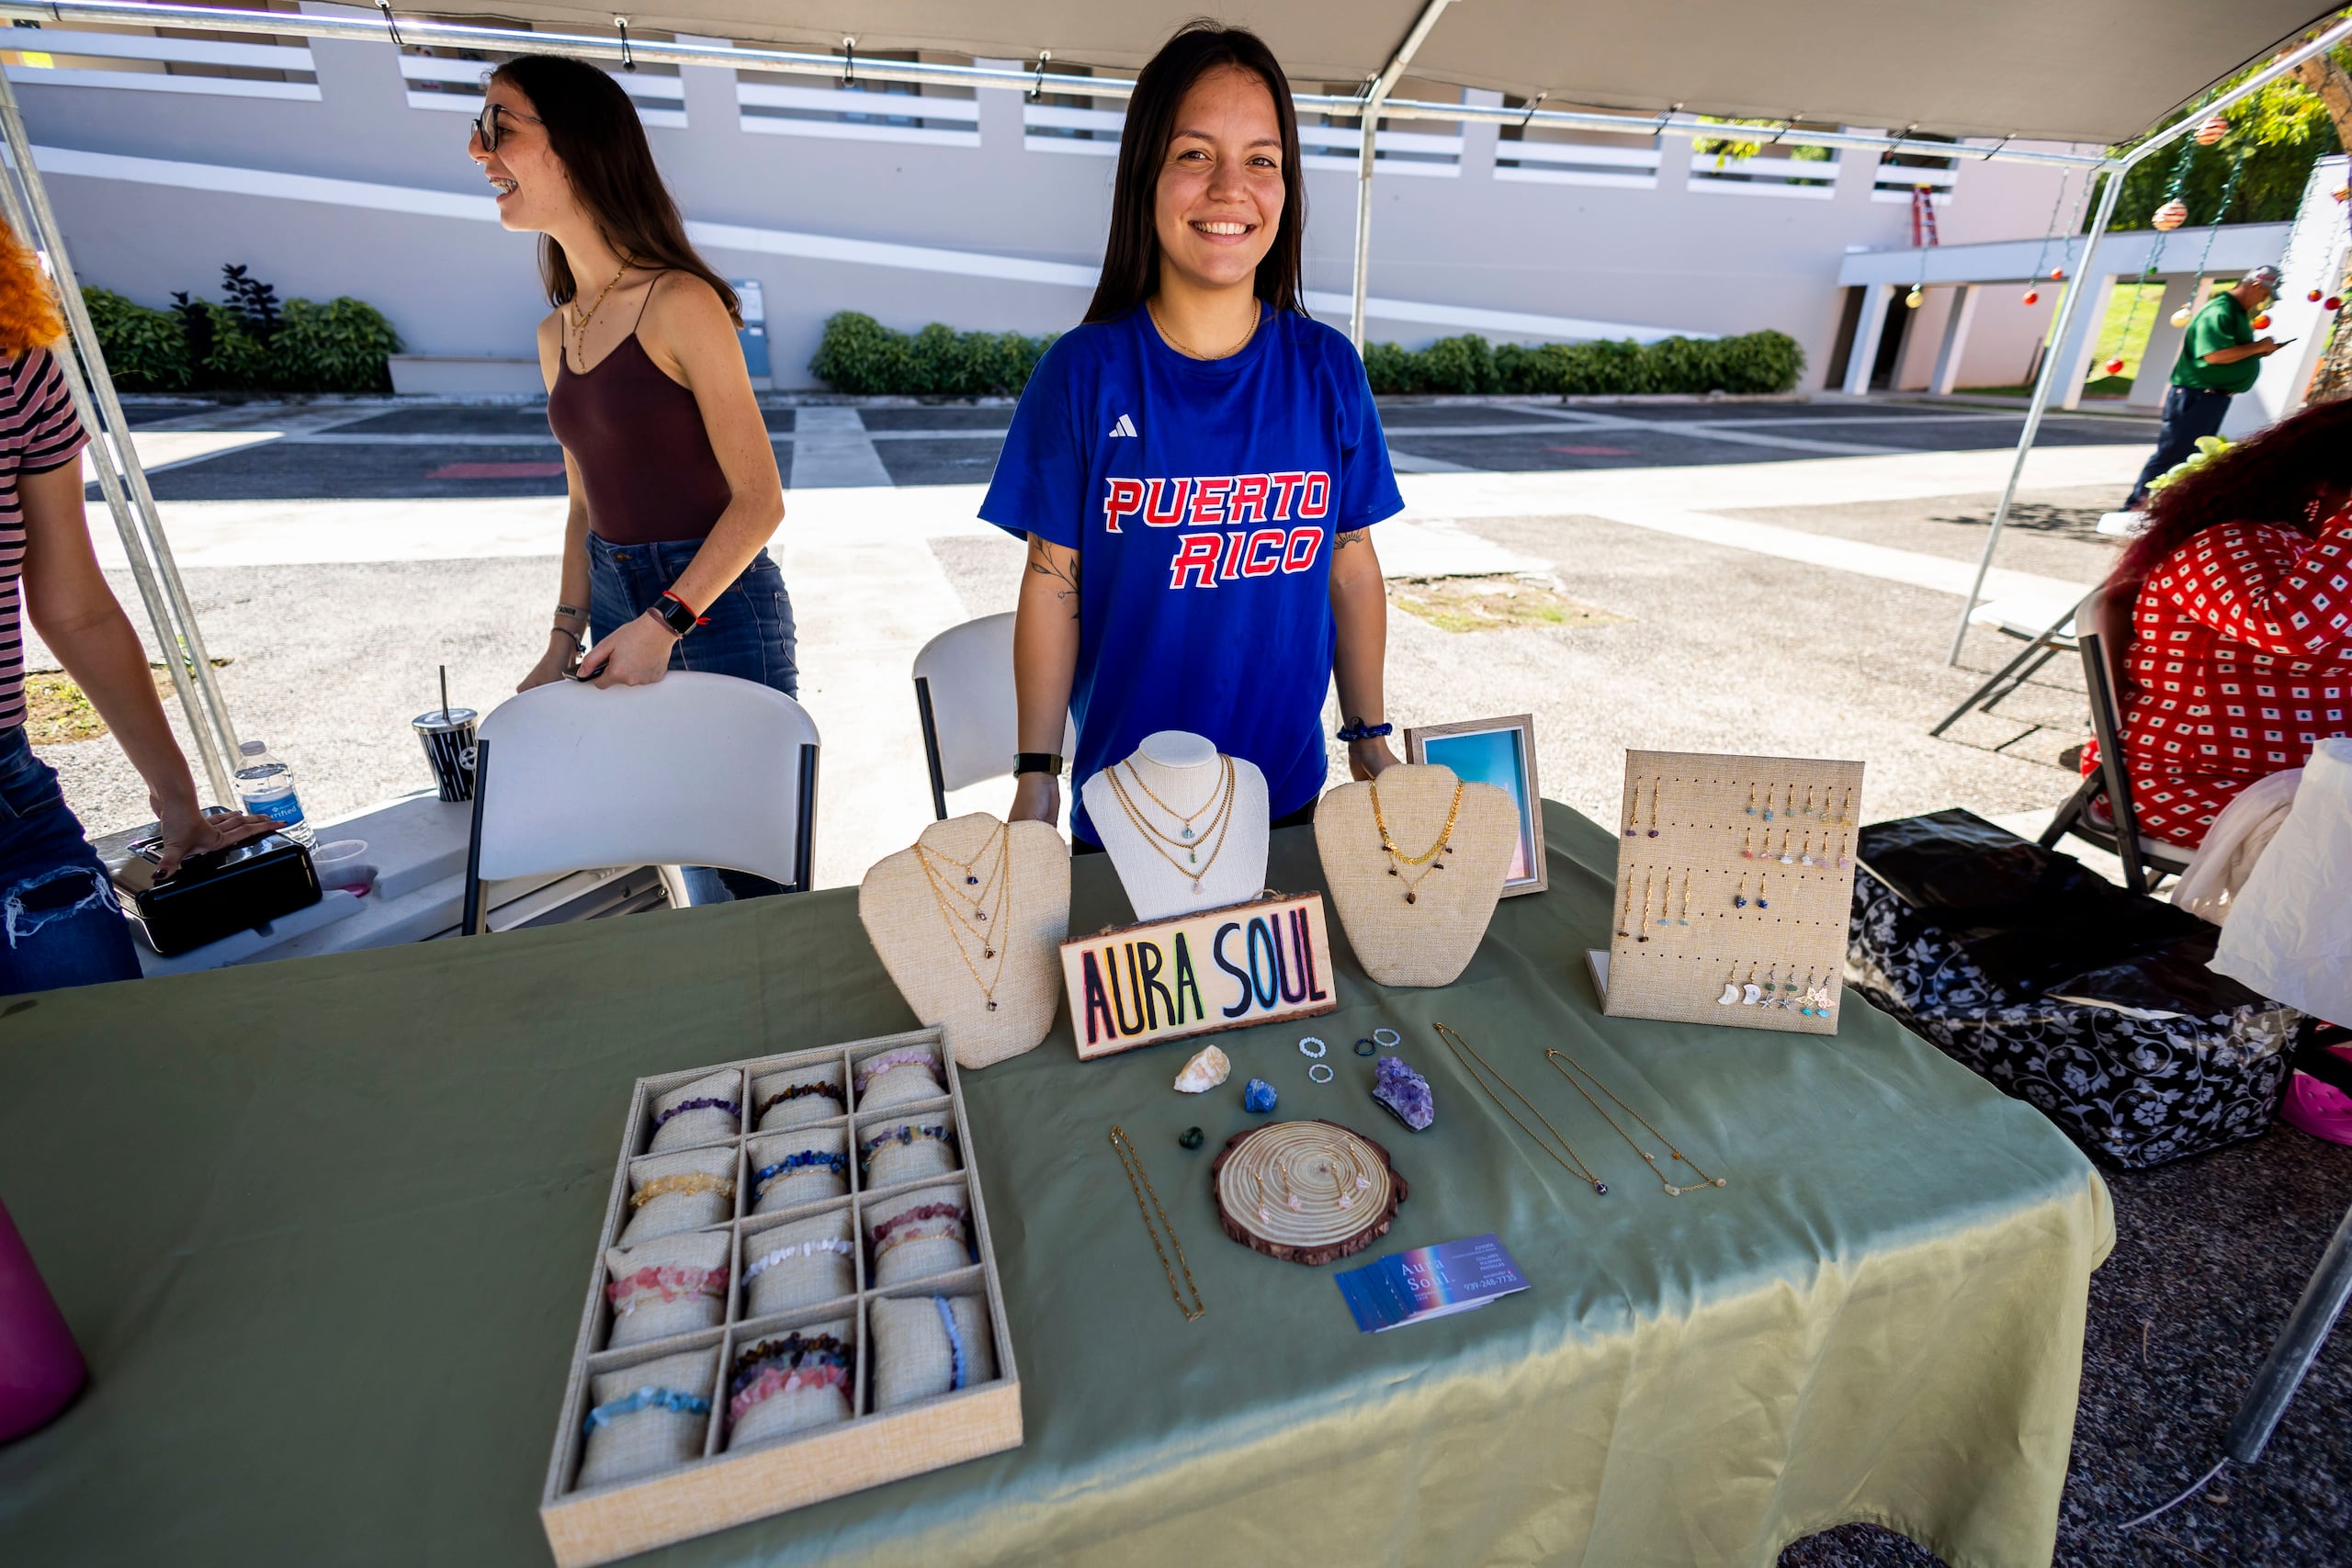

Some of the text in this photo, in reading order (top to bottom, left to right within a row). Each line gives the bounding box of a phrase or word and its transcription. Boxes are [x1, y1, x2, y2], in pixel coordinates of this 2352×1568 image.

[1103, 471, 1331, 534] PUERTO
[1170, 526, 1324, 589] RICO
[269, 805, 297, 819] urified
[1081, 906, 1327, 1046] AURA SOUL
[1401, 1259, 1444, 1276] Aura
[1407, 1271, 1450, 1291] Soul
